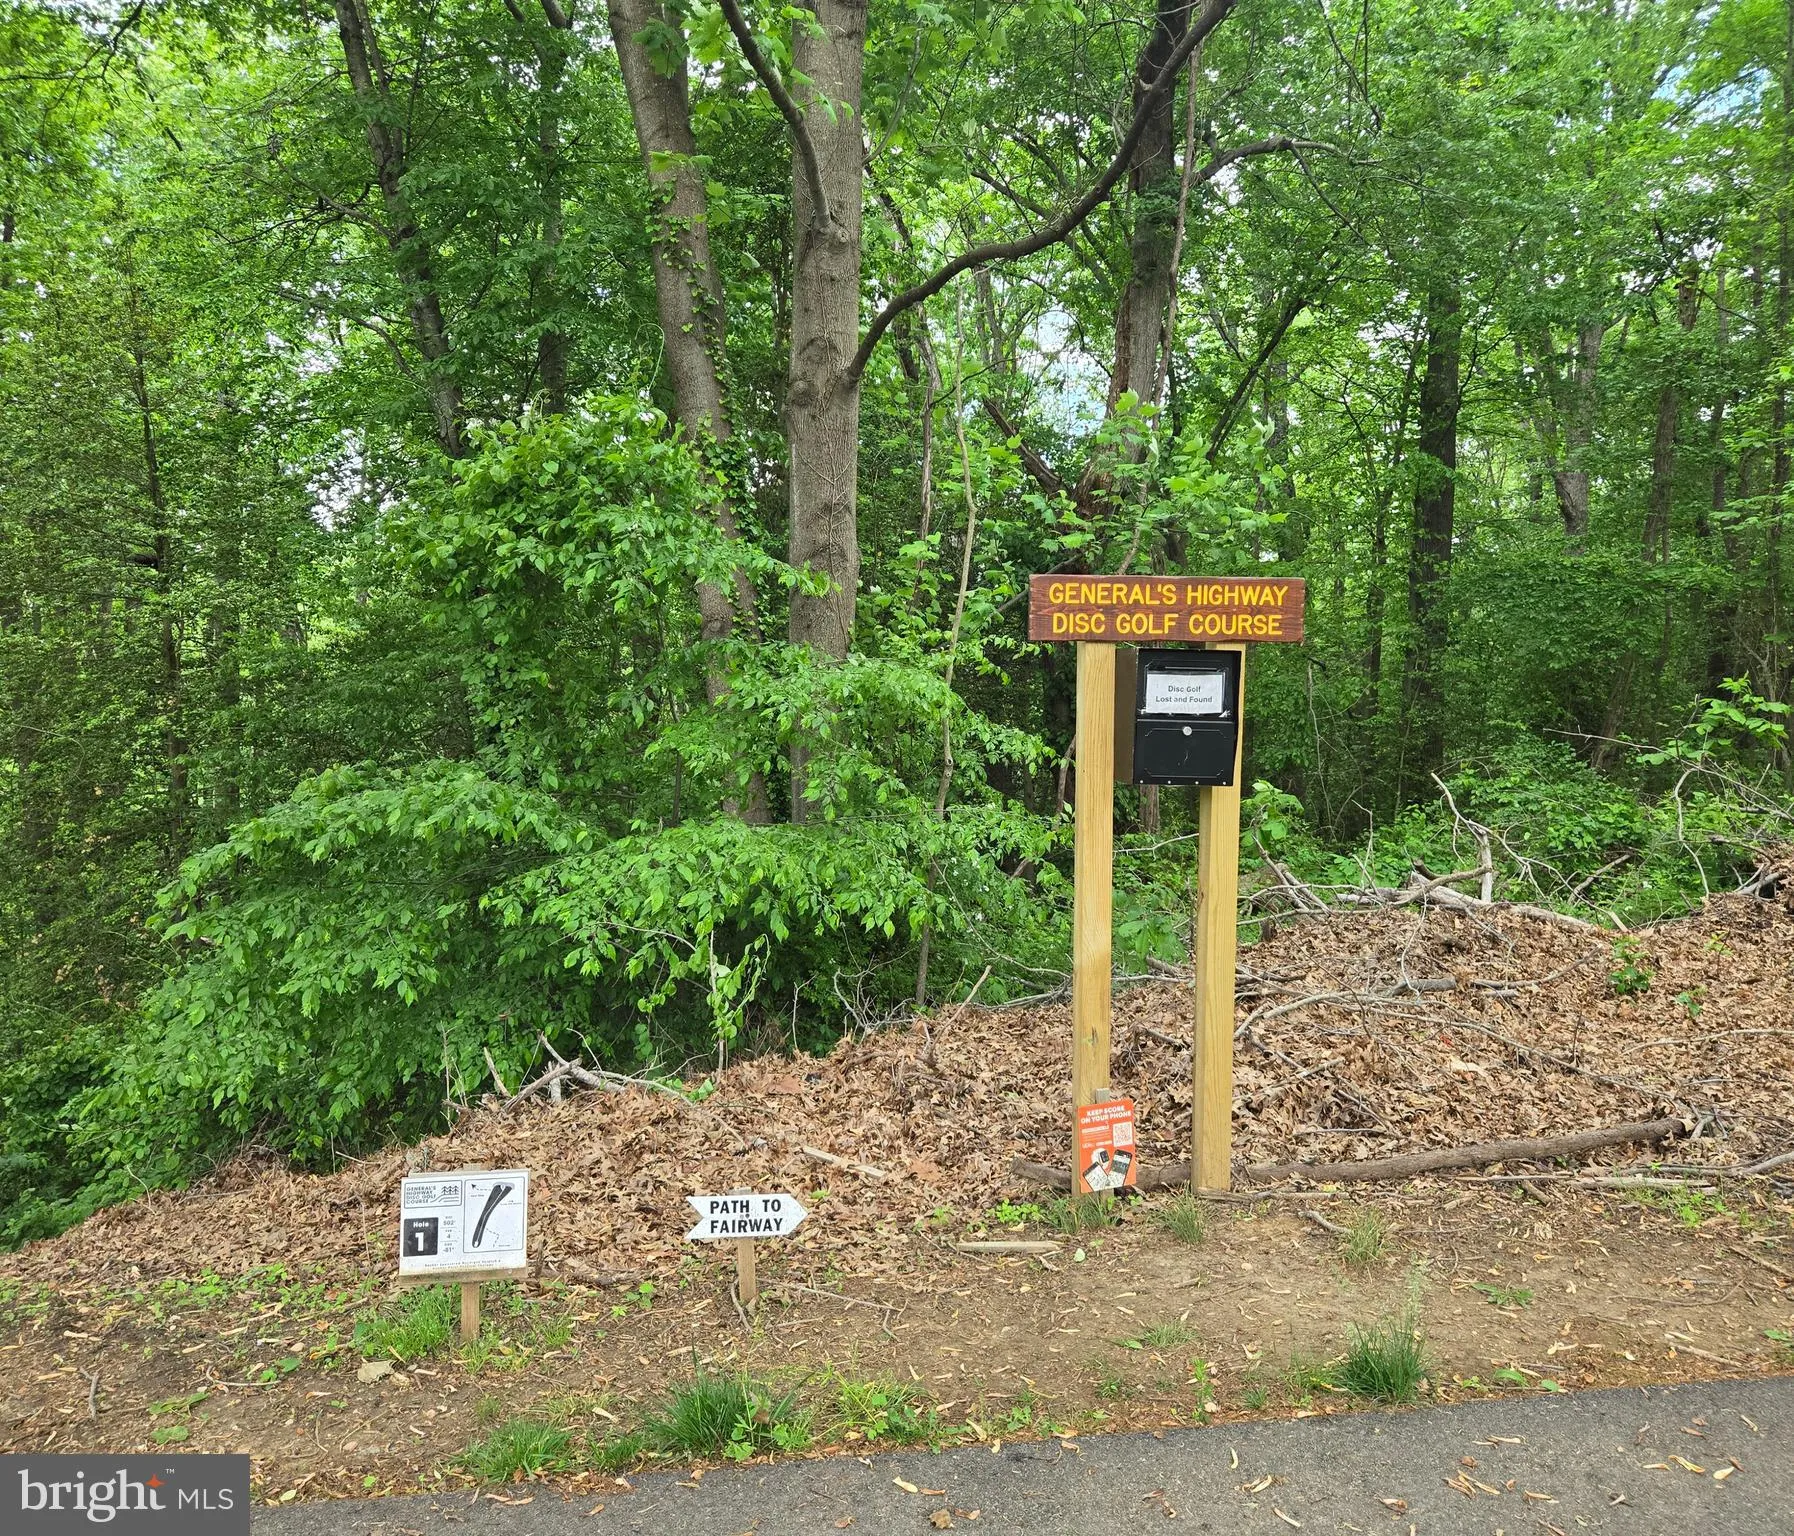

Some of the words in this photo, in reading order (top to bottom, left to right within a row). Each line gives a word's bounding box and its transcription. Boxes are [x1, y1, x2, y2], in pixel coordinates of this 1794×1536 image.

[1049, 582, 1177, 605] GENERAL'S
[1186, 585, 1288, 606] HIGHWAY
[1053, 613, 1105, 634] DISC
[1116, 613, 1179, 634] GOLF
[1188, 614, 1282, 635] COURSE
[1091, 1114, 1109, 1122] YOUR
[1110, 1110, 1131, 1119] PHONE
[1104, 1105, 1125, 1113] SCORE
[710, 1200, 750, 1214] PATH
[762, 1199, 781, 1212] TO
[710, 1218, 783, 1233] FAIRWAY
[415, 1232, 424, 1252] 1
